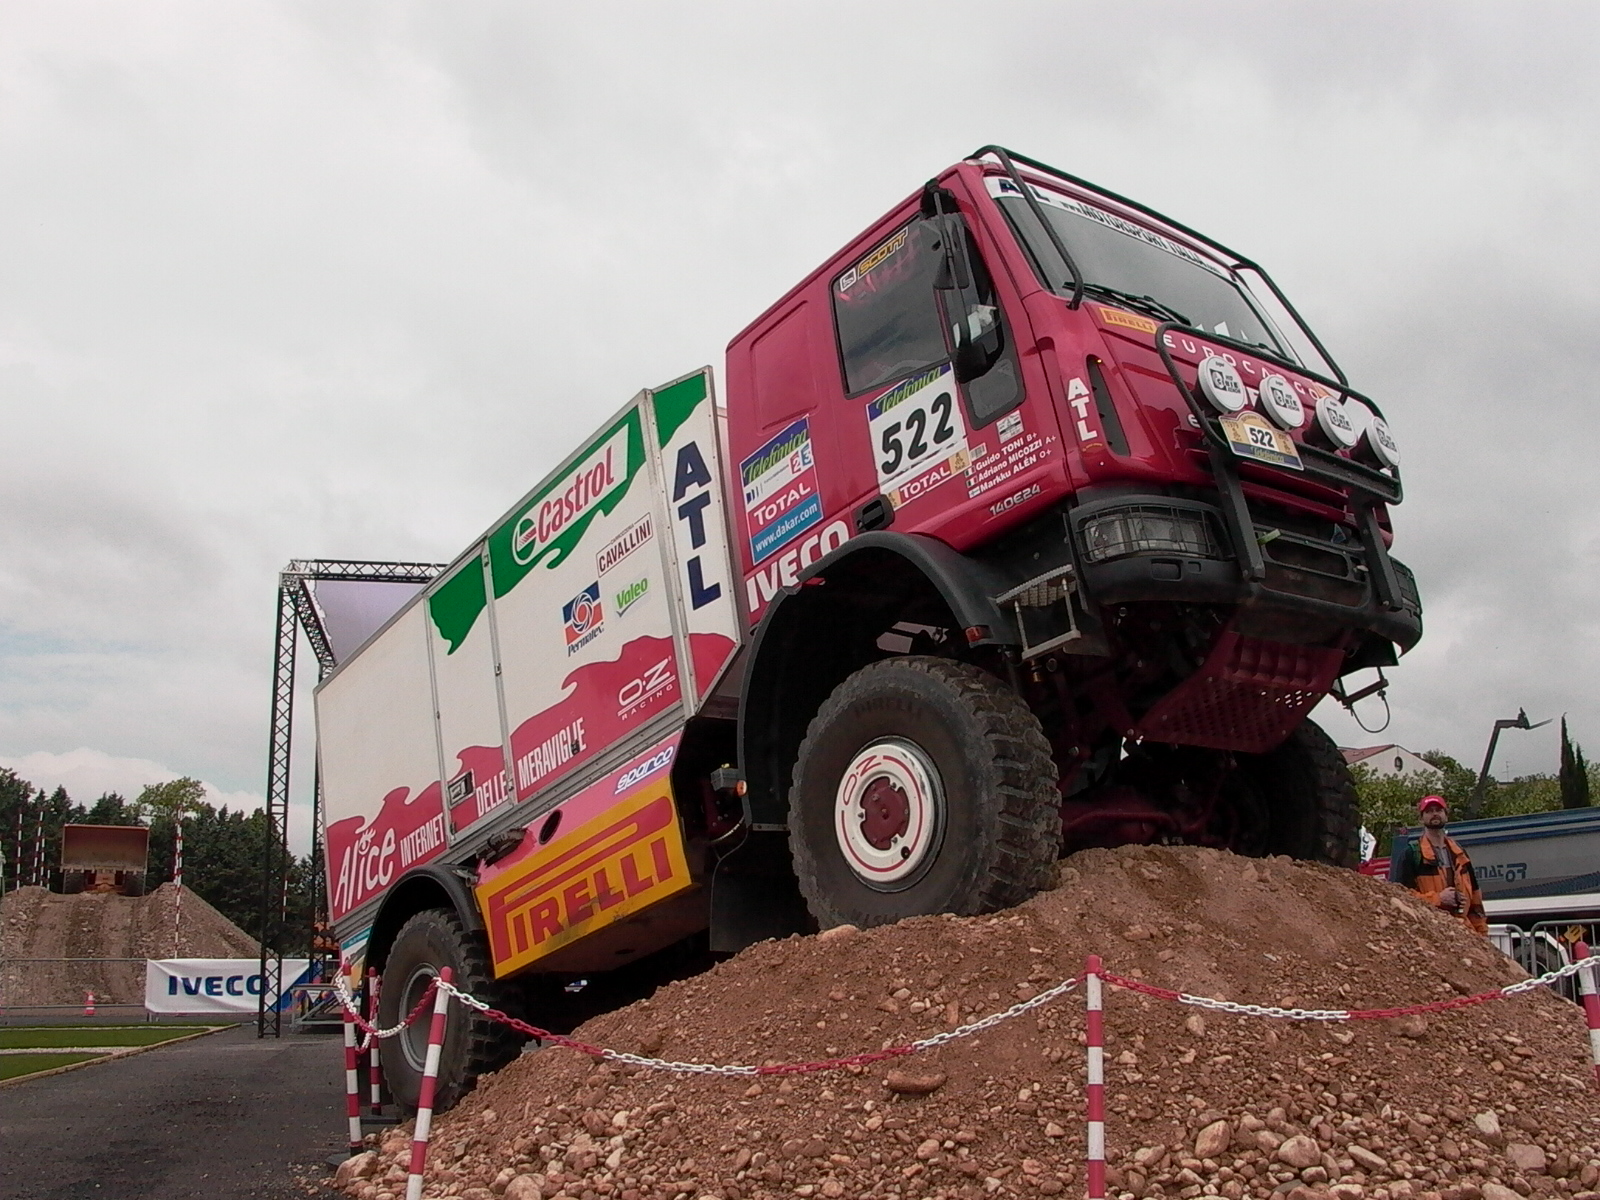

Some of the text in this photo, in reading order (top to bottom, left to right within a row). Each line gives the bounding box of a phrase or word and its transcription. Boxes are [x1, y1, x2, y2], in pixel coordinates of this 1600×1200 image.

[860, 232, 905, 275] SCOTT
[1104, 310, 1154, 332] PIRELLI
[1067, 377, 1097, 441] ATL
[881, 392, 954, 475] 522
[975, 453, 1000, 471] Guido
[1001, 437, 1024, 455] TONI
[1249, 427, 1275, 448] 522
[977, 462, 1008, 482] Adriano
[1008, 439, 1042, 464] MICOZZI
[980, 470, 1011, 493] Markku
[538, 445, 614, 543] Castrol
[754, 483, 811, 526] TOTAL
[900, 467, 951, 499] TOTAL
[990, 483, 1041, 516] 140E24
[599, 520, 651, 572] CAVALLINI
[673, 441, 721, 611] ATL
[755, 502, 818, 552] www.dakar.com
[746, 520, 849, 613] IVECO
[616, 578, 648, 610] Valeo
[621, 684, 674, 721] RACING
[617, 746, 674, 791] sparco
[334, 828, 396, 913] Alice
[400, 812, 445, 868] INTERNET
[475, 770, 508, 817] DELLE
[488, 796, 673, 966] PIRELLI
[168, 975, 270, 996] IVECO
